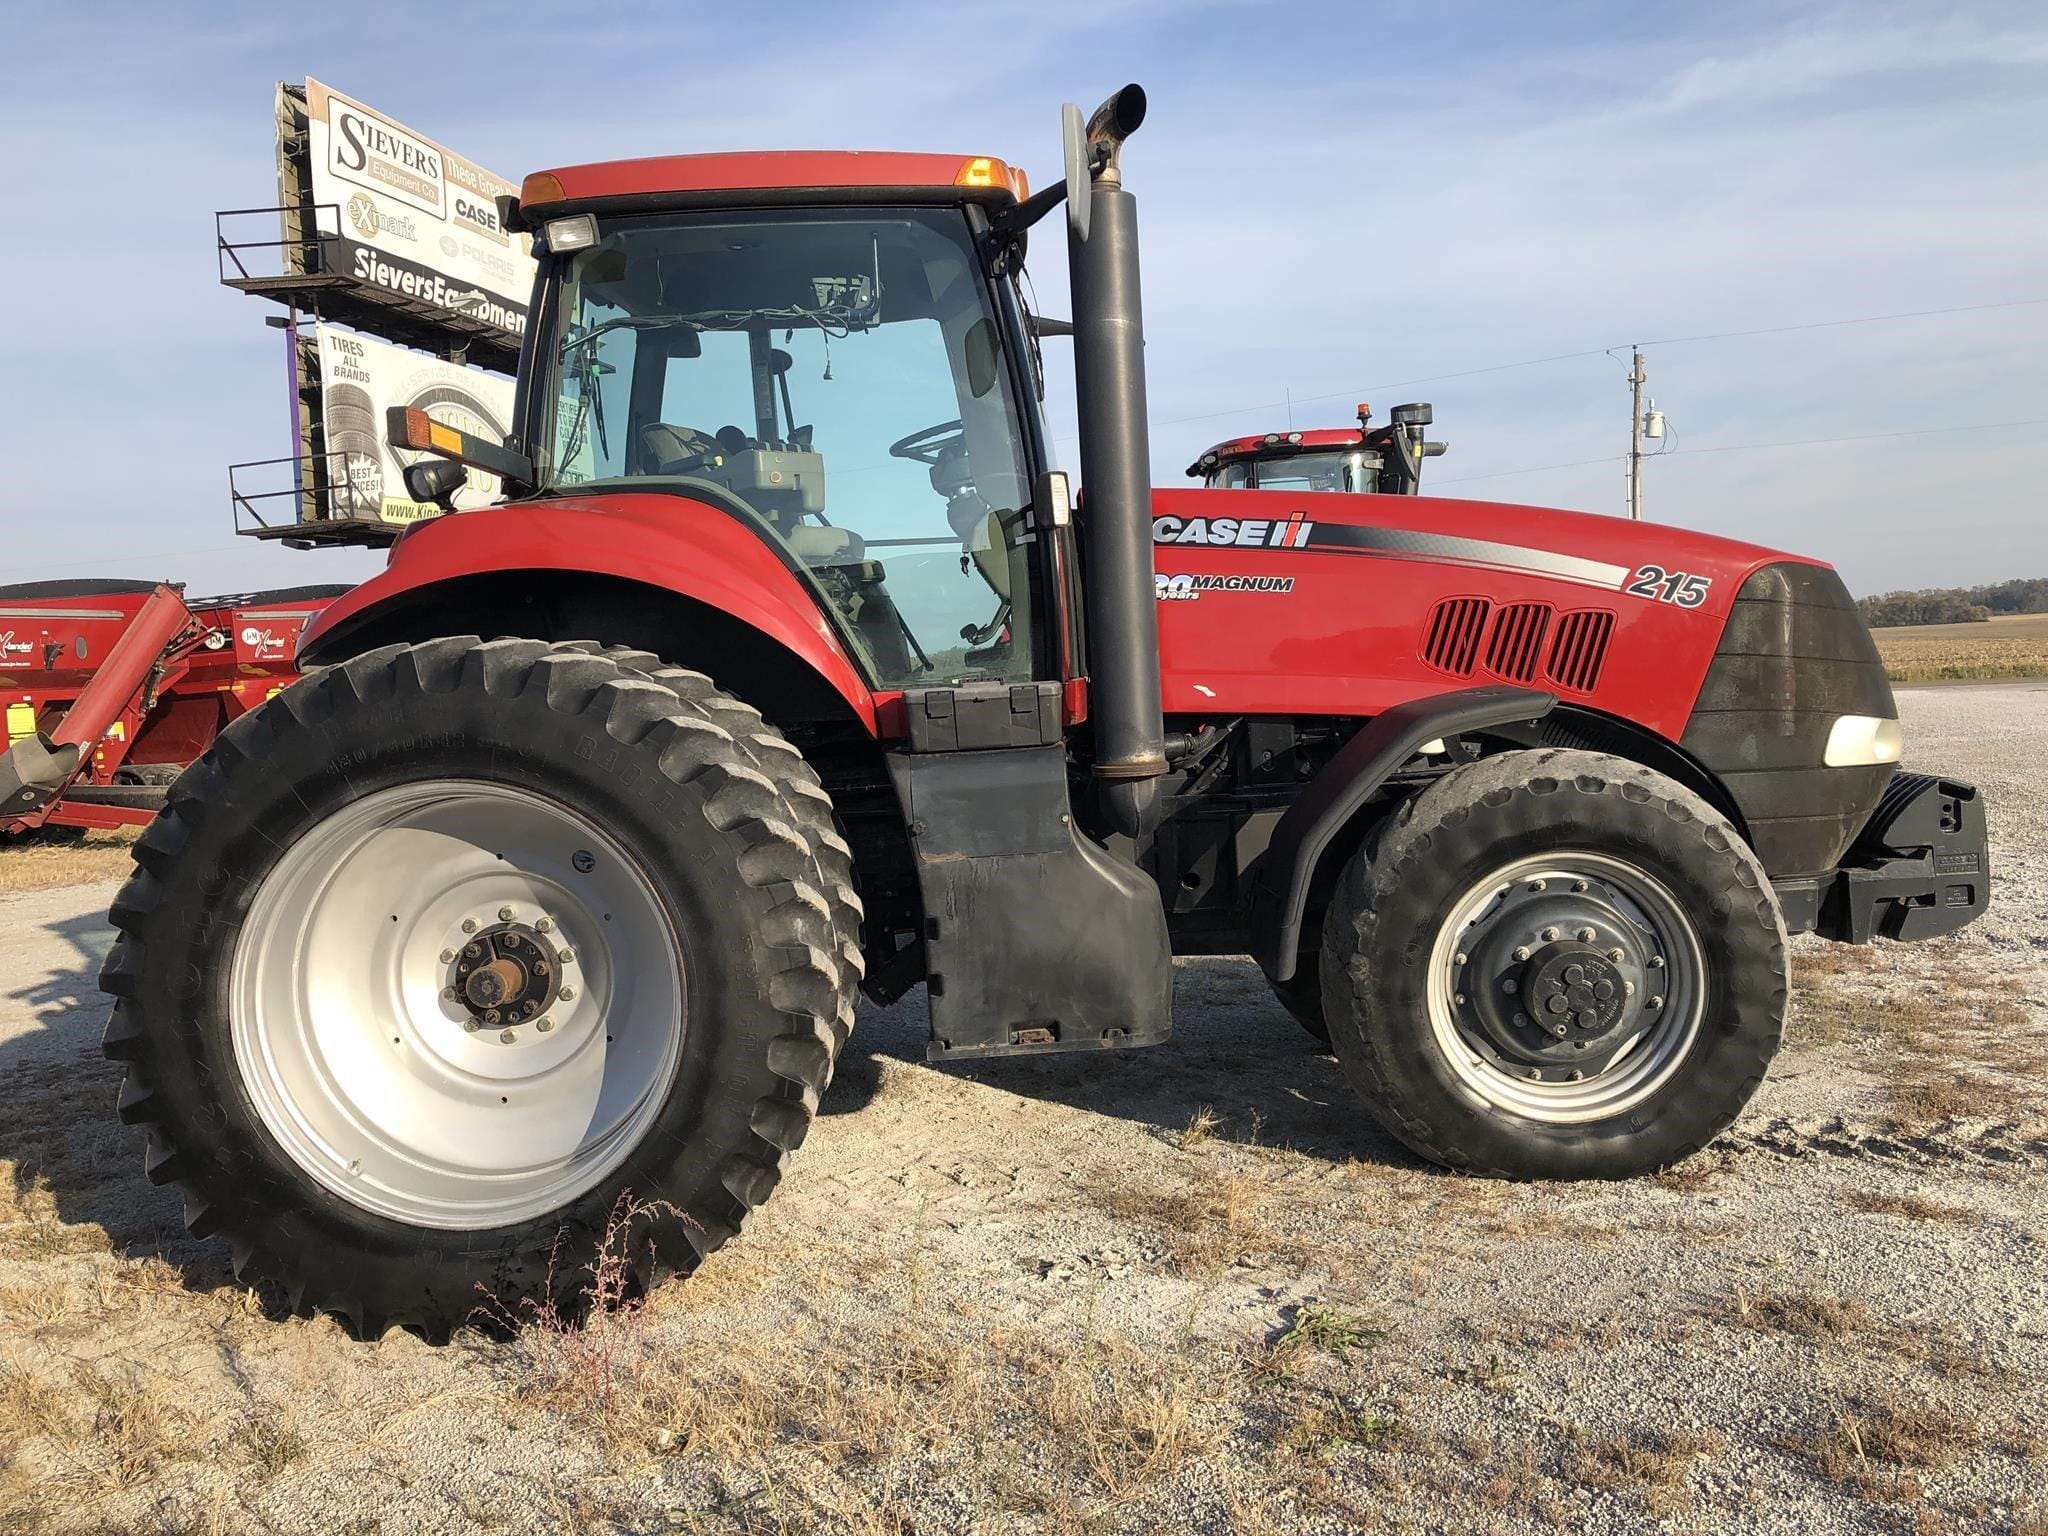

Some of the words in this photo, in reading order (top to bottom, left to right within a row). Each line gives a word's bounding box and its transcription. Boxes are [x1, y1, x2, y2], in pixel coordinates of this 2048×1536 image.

[337, 113, 438, 179] SIEVERS
[372, 160, 420, 194] Equipment
[422, 183, 438, 200] Co.
[444, 154, 477, 188] These
[456, 199, 496, 231] CASE
[330, 336, 363, 357] TIRES
[343, 355, 359, 369] ALL
[334, 366, 370, 383] BRANDS
[351, 468, 371, 479] BEST
[345, 480, 379, 492] ICES!
[1153, 516, 1269, 546] CASE
[1191, 575, 1295, 592] MAGNUM
[1627, 565, 1712, 608] 215
[1161, 591, 1200, 600] years
